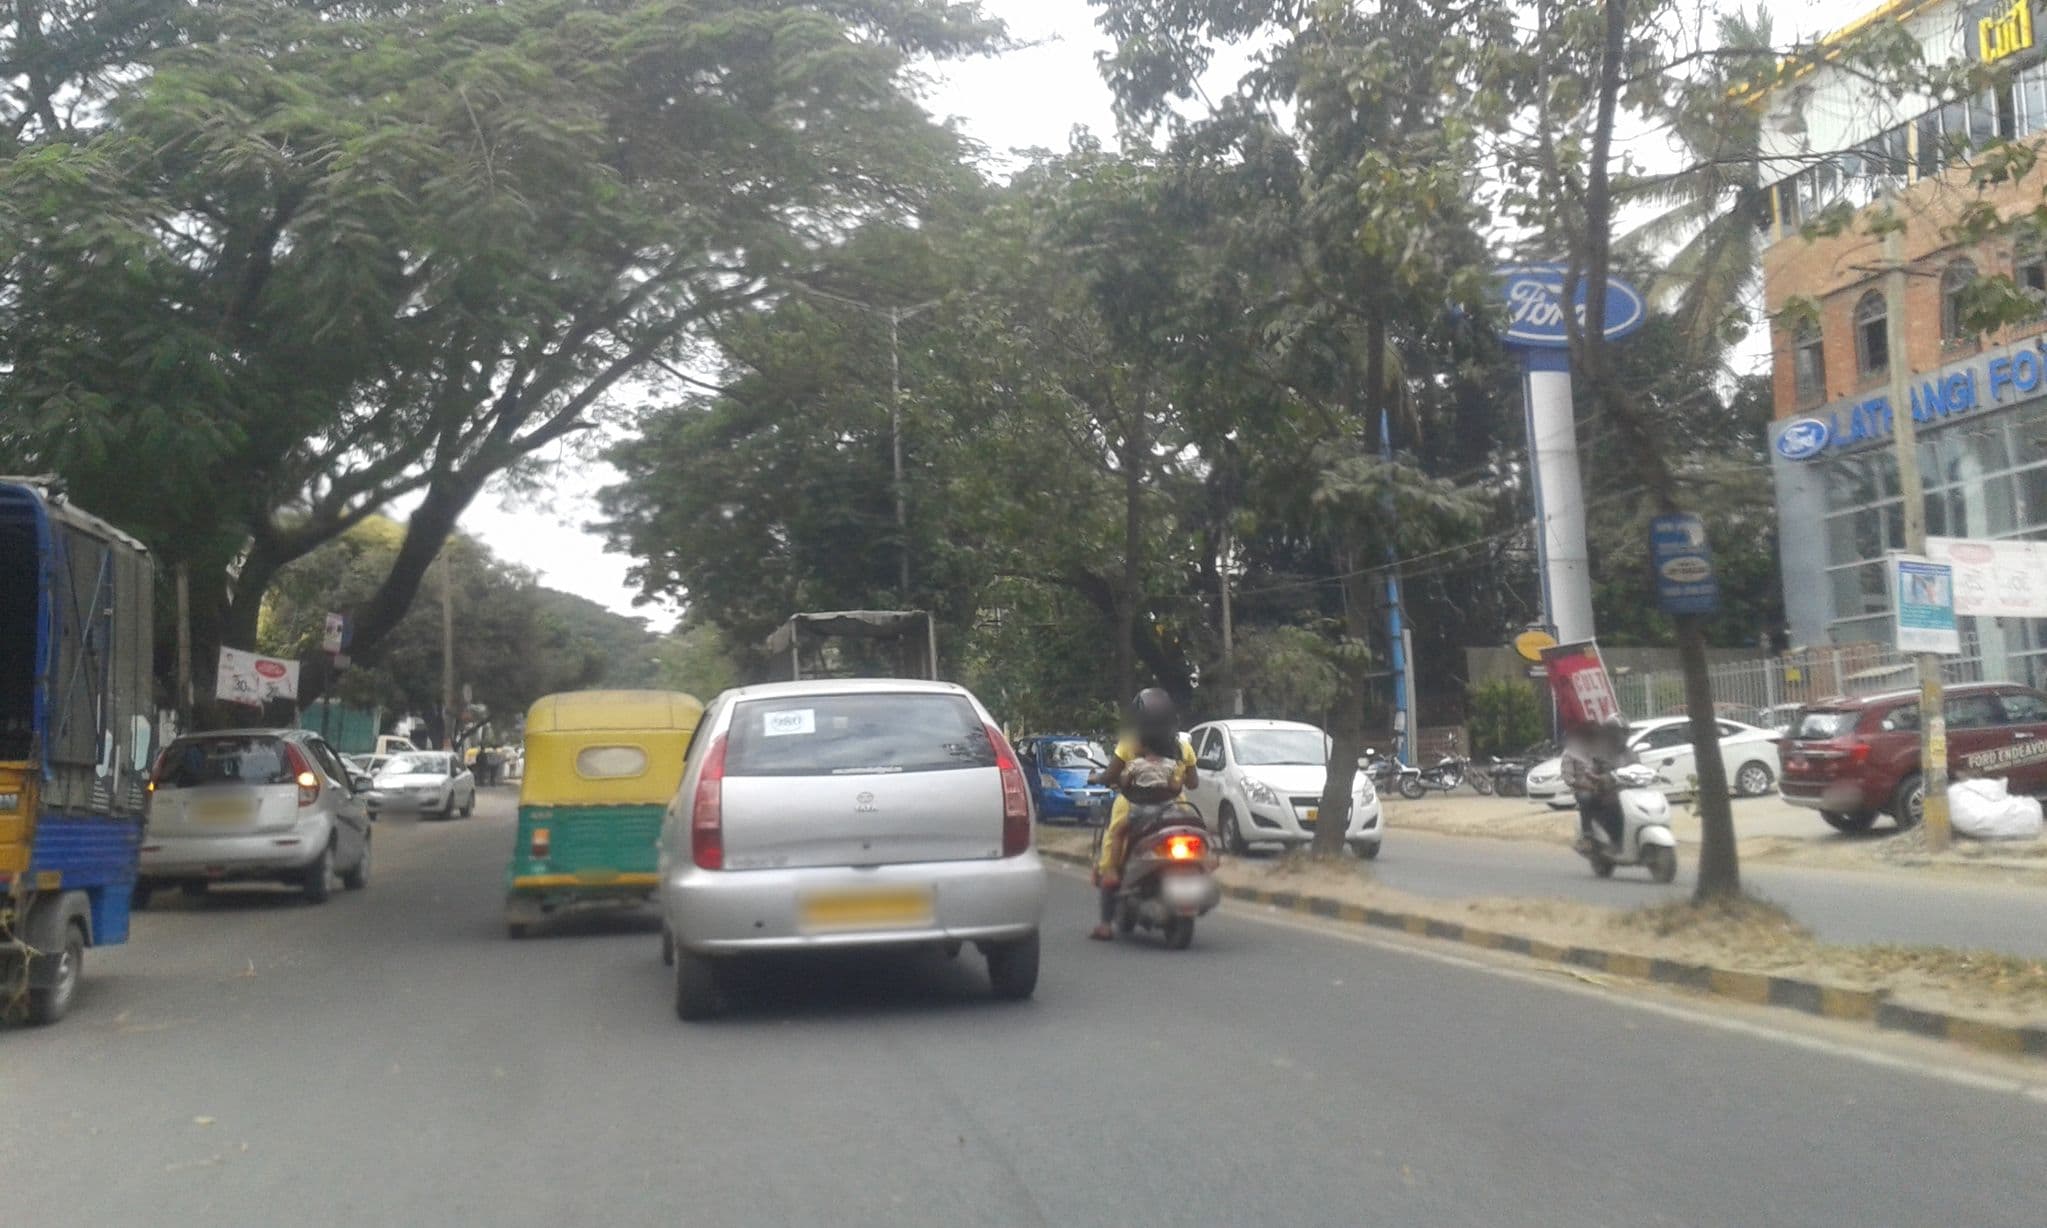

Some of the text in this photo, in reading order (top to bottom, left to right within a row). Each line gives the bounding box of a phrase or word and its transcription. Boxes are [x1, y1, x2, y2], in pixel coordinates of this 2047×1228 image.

[1988, 343, 2047, 402] FO
[1968, 751, 1997, 769] FORD
[1998, 740, 2047, 762] ENDEAVO
